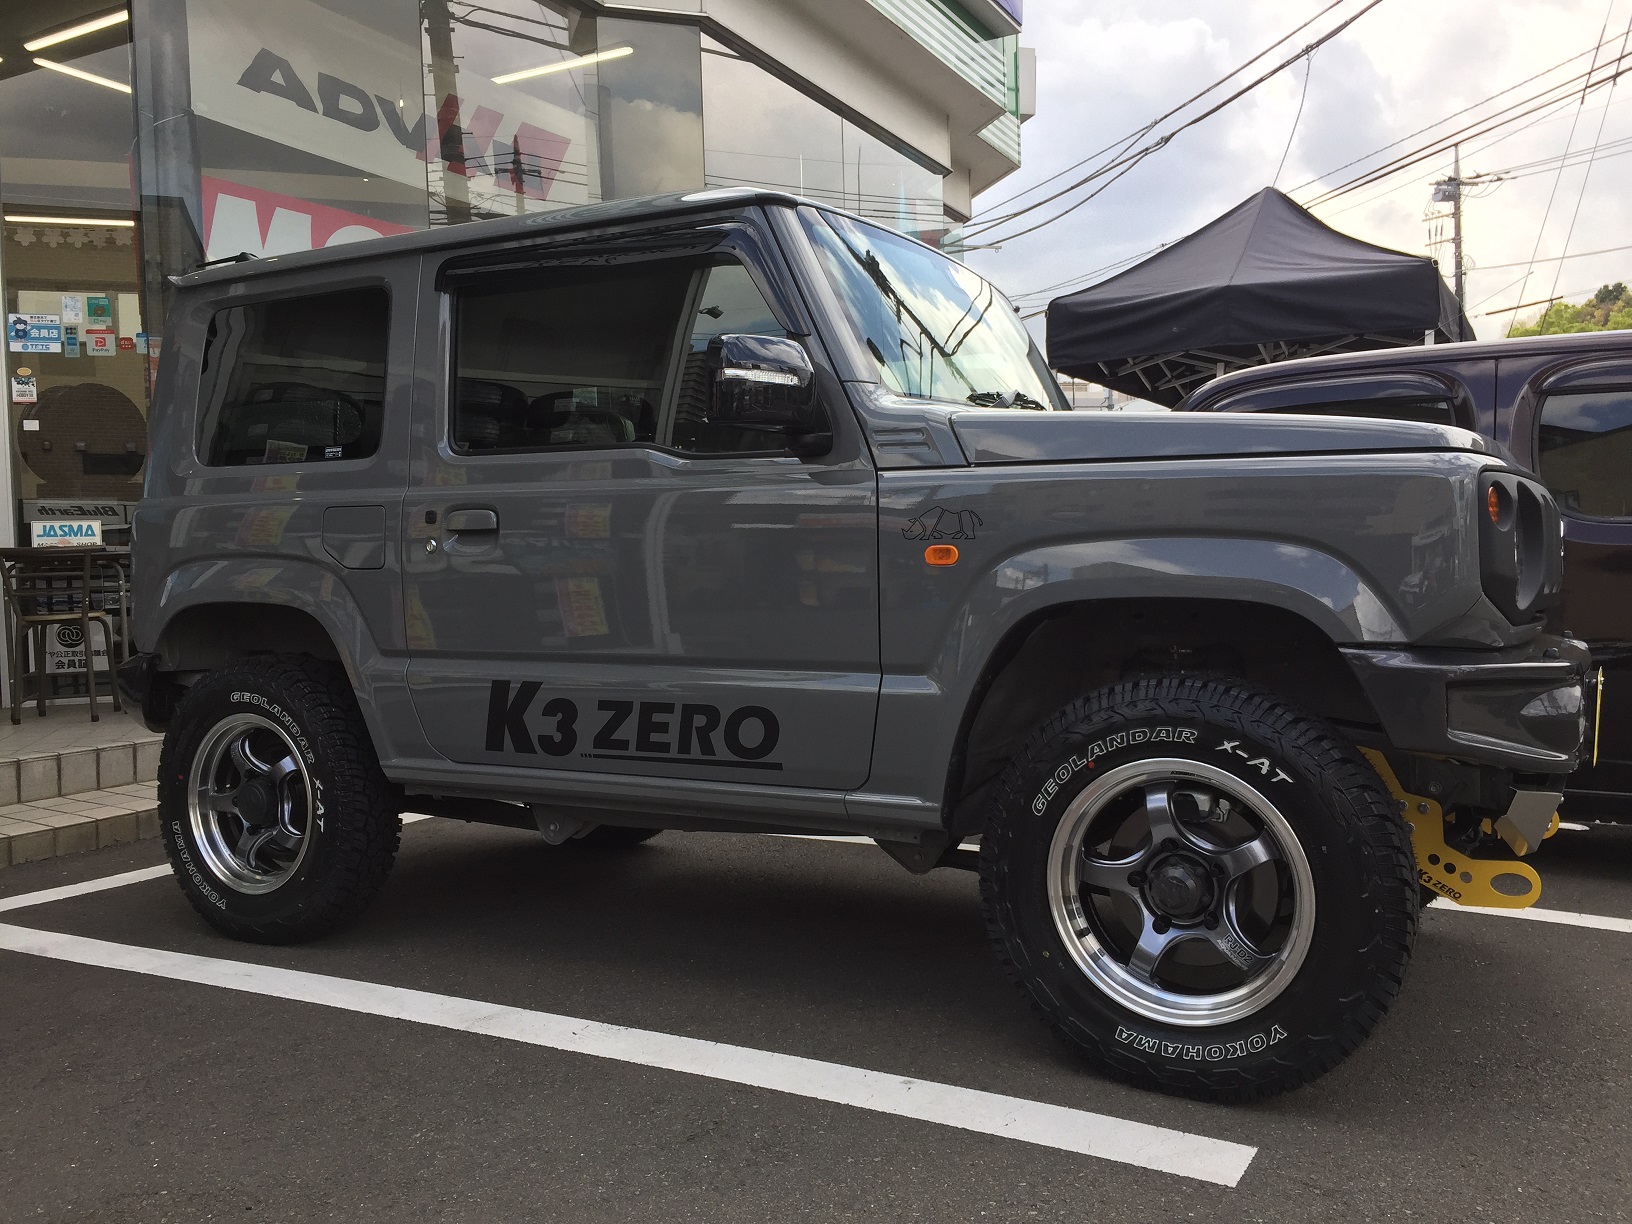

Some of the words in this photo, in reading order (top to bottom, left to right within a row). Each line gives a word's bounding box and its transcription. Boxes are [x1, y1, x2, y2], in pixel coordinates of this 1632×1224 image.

[30, 328, 59, 338] 会員店
[36, 524, 97, 538] JASMA
[485, 679, 579, 757] K3
[592, 699, 780, 761] ZERO
[230, 691, 315, 765] GEOLANDAR
[312, 777, 326, 833] X-AT
[1031, 727, 1198, 817] GEOLANDAR
[1214, 739, 1294, 784] X-AT
[172, 820, 227, 910] YOKOHAMA
[1432, 879, 1462, 899] ZERO
[1114, 1024, 1288, 1061] YOKOHAMA
